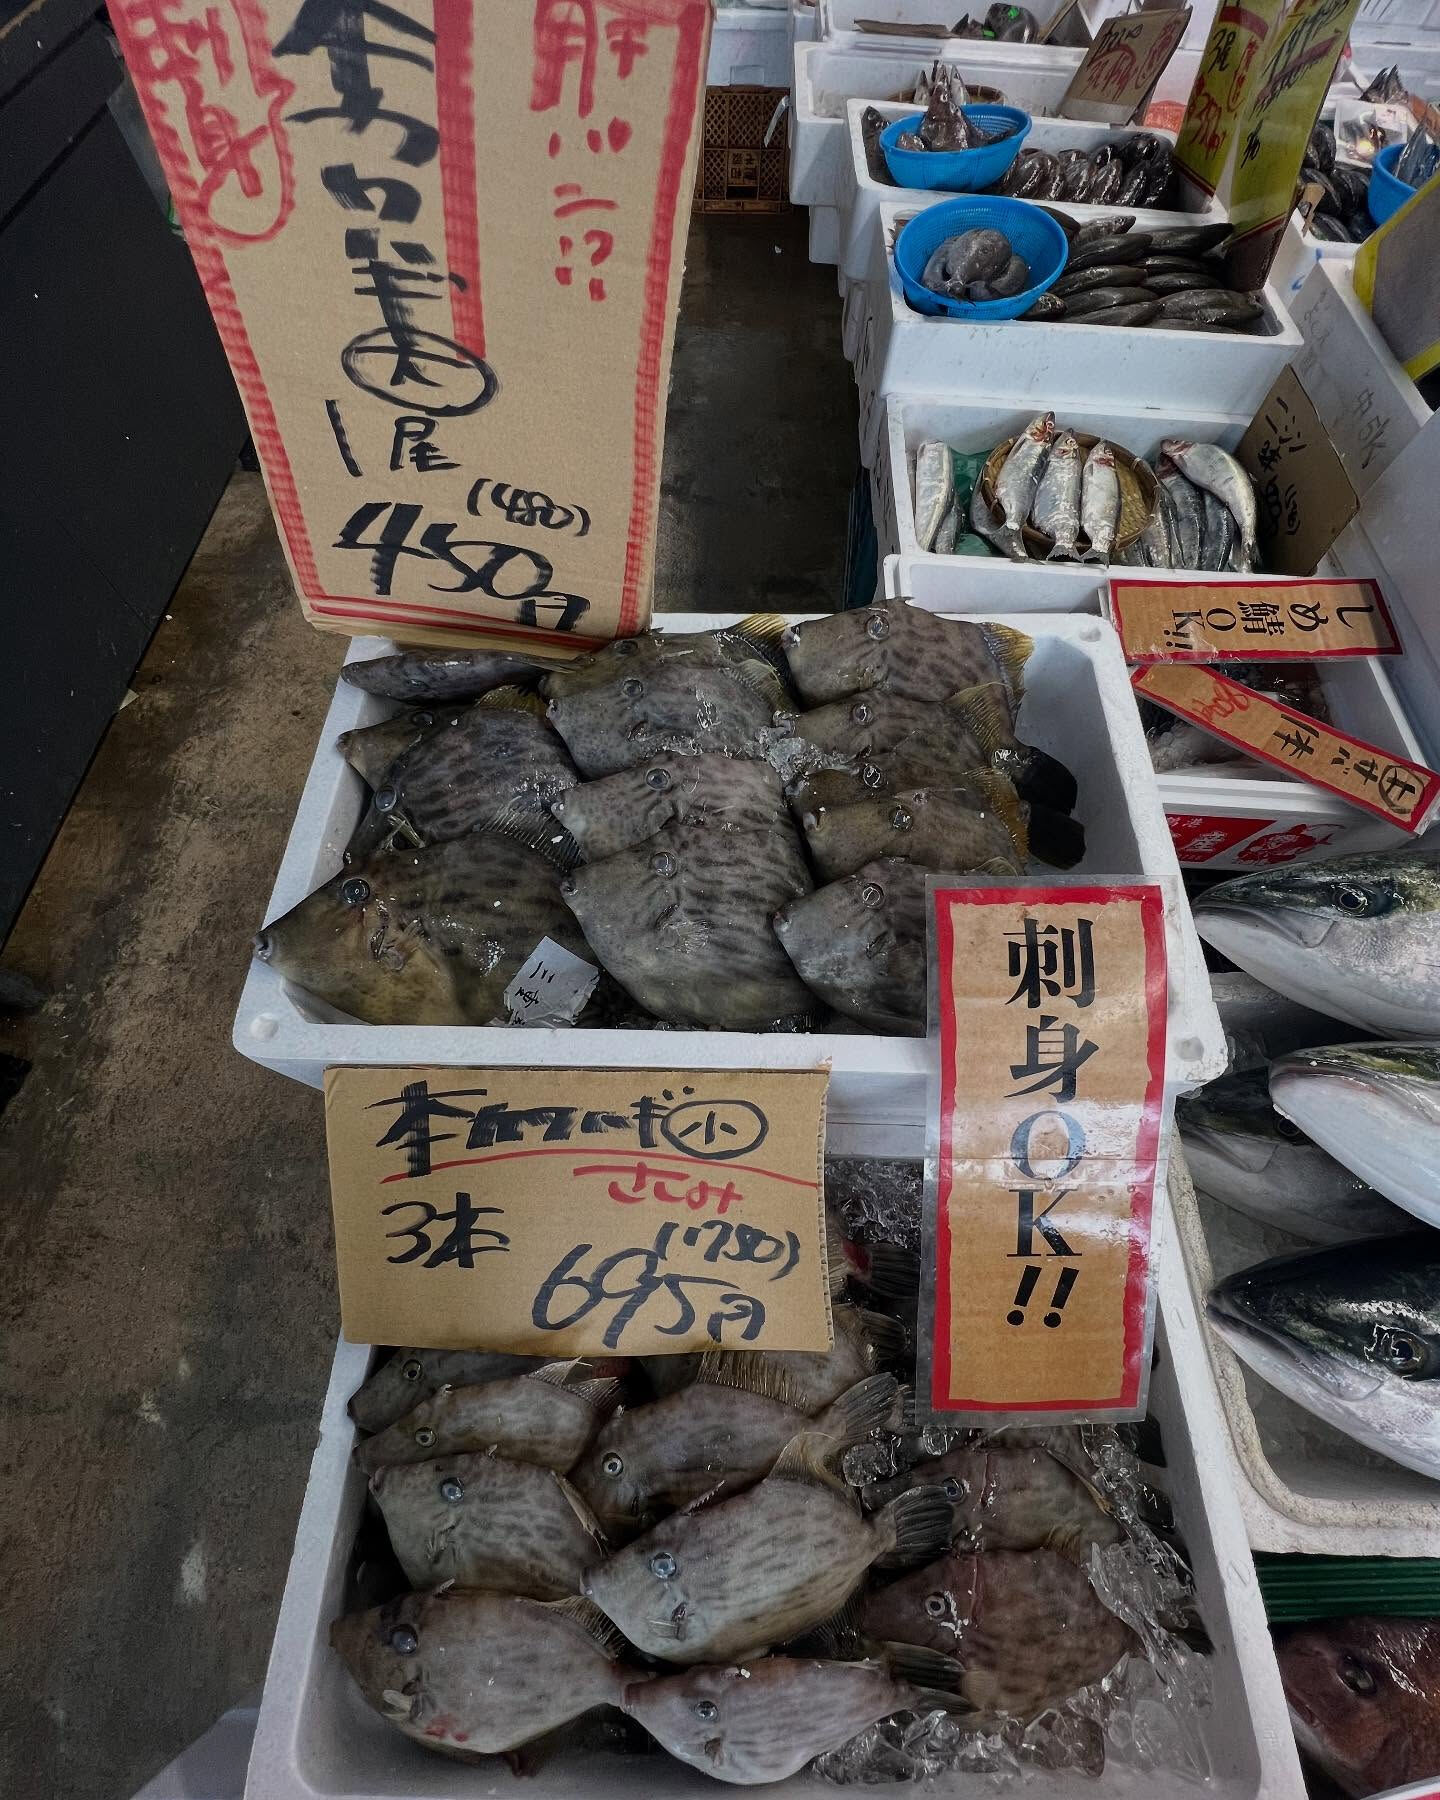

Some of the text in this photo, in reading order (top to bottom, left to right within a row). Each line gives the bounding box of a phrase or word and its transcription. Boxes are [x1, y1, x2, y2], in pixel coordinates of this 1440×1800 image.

[1003, 917, 1100, 1329] 刺身OK!!
[380, 1191, 510, 1269] 3本
[531, 1243, 767, 1350] 695円
